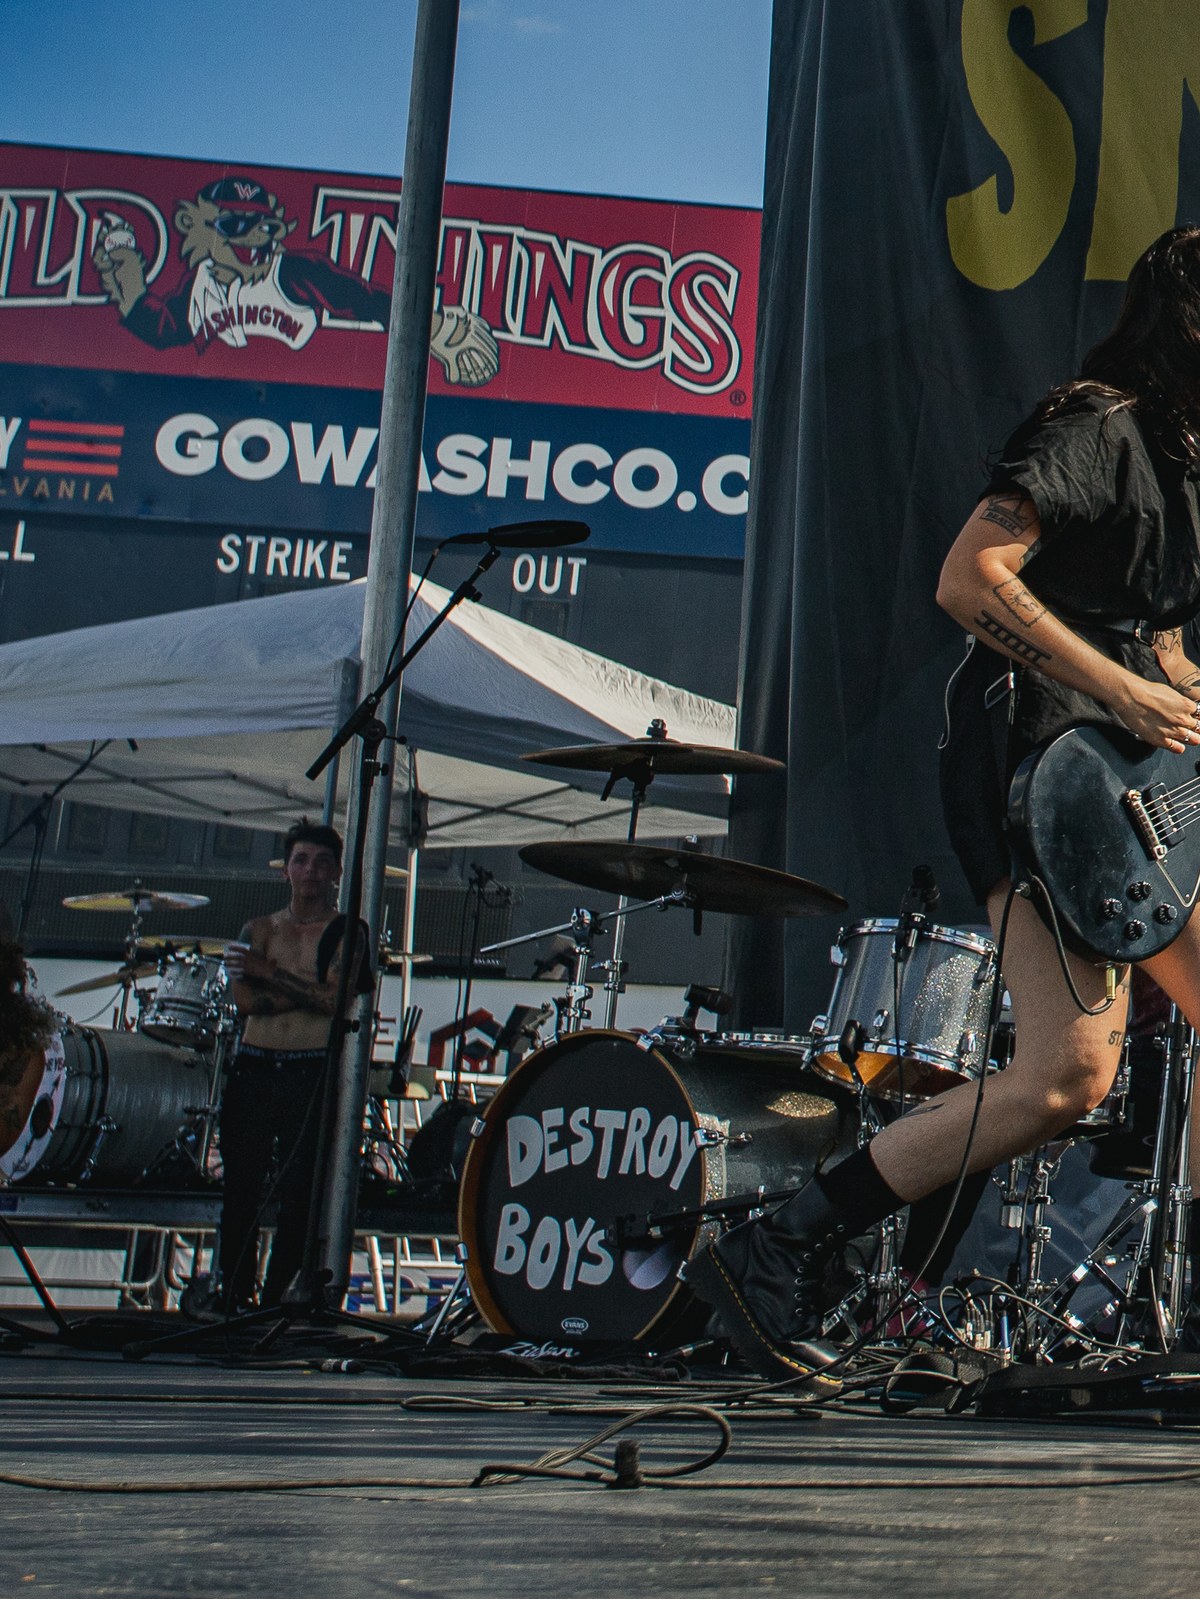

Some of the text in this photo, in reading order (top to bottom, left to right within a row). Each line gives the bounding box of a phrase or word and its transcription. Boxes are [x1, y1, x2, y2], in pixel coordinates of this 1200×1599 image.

[156, 413, 750, 515] GOWSHCO.C
[217, 533, 353, 580] STRIKE
[512, 553, 587, 596] OUT
[506, 1107, 699, 1190] DESTROY
[494, 1203, 614, 1291] BOYS
